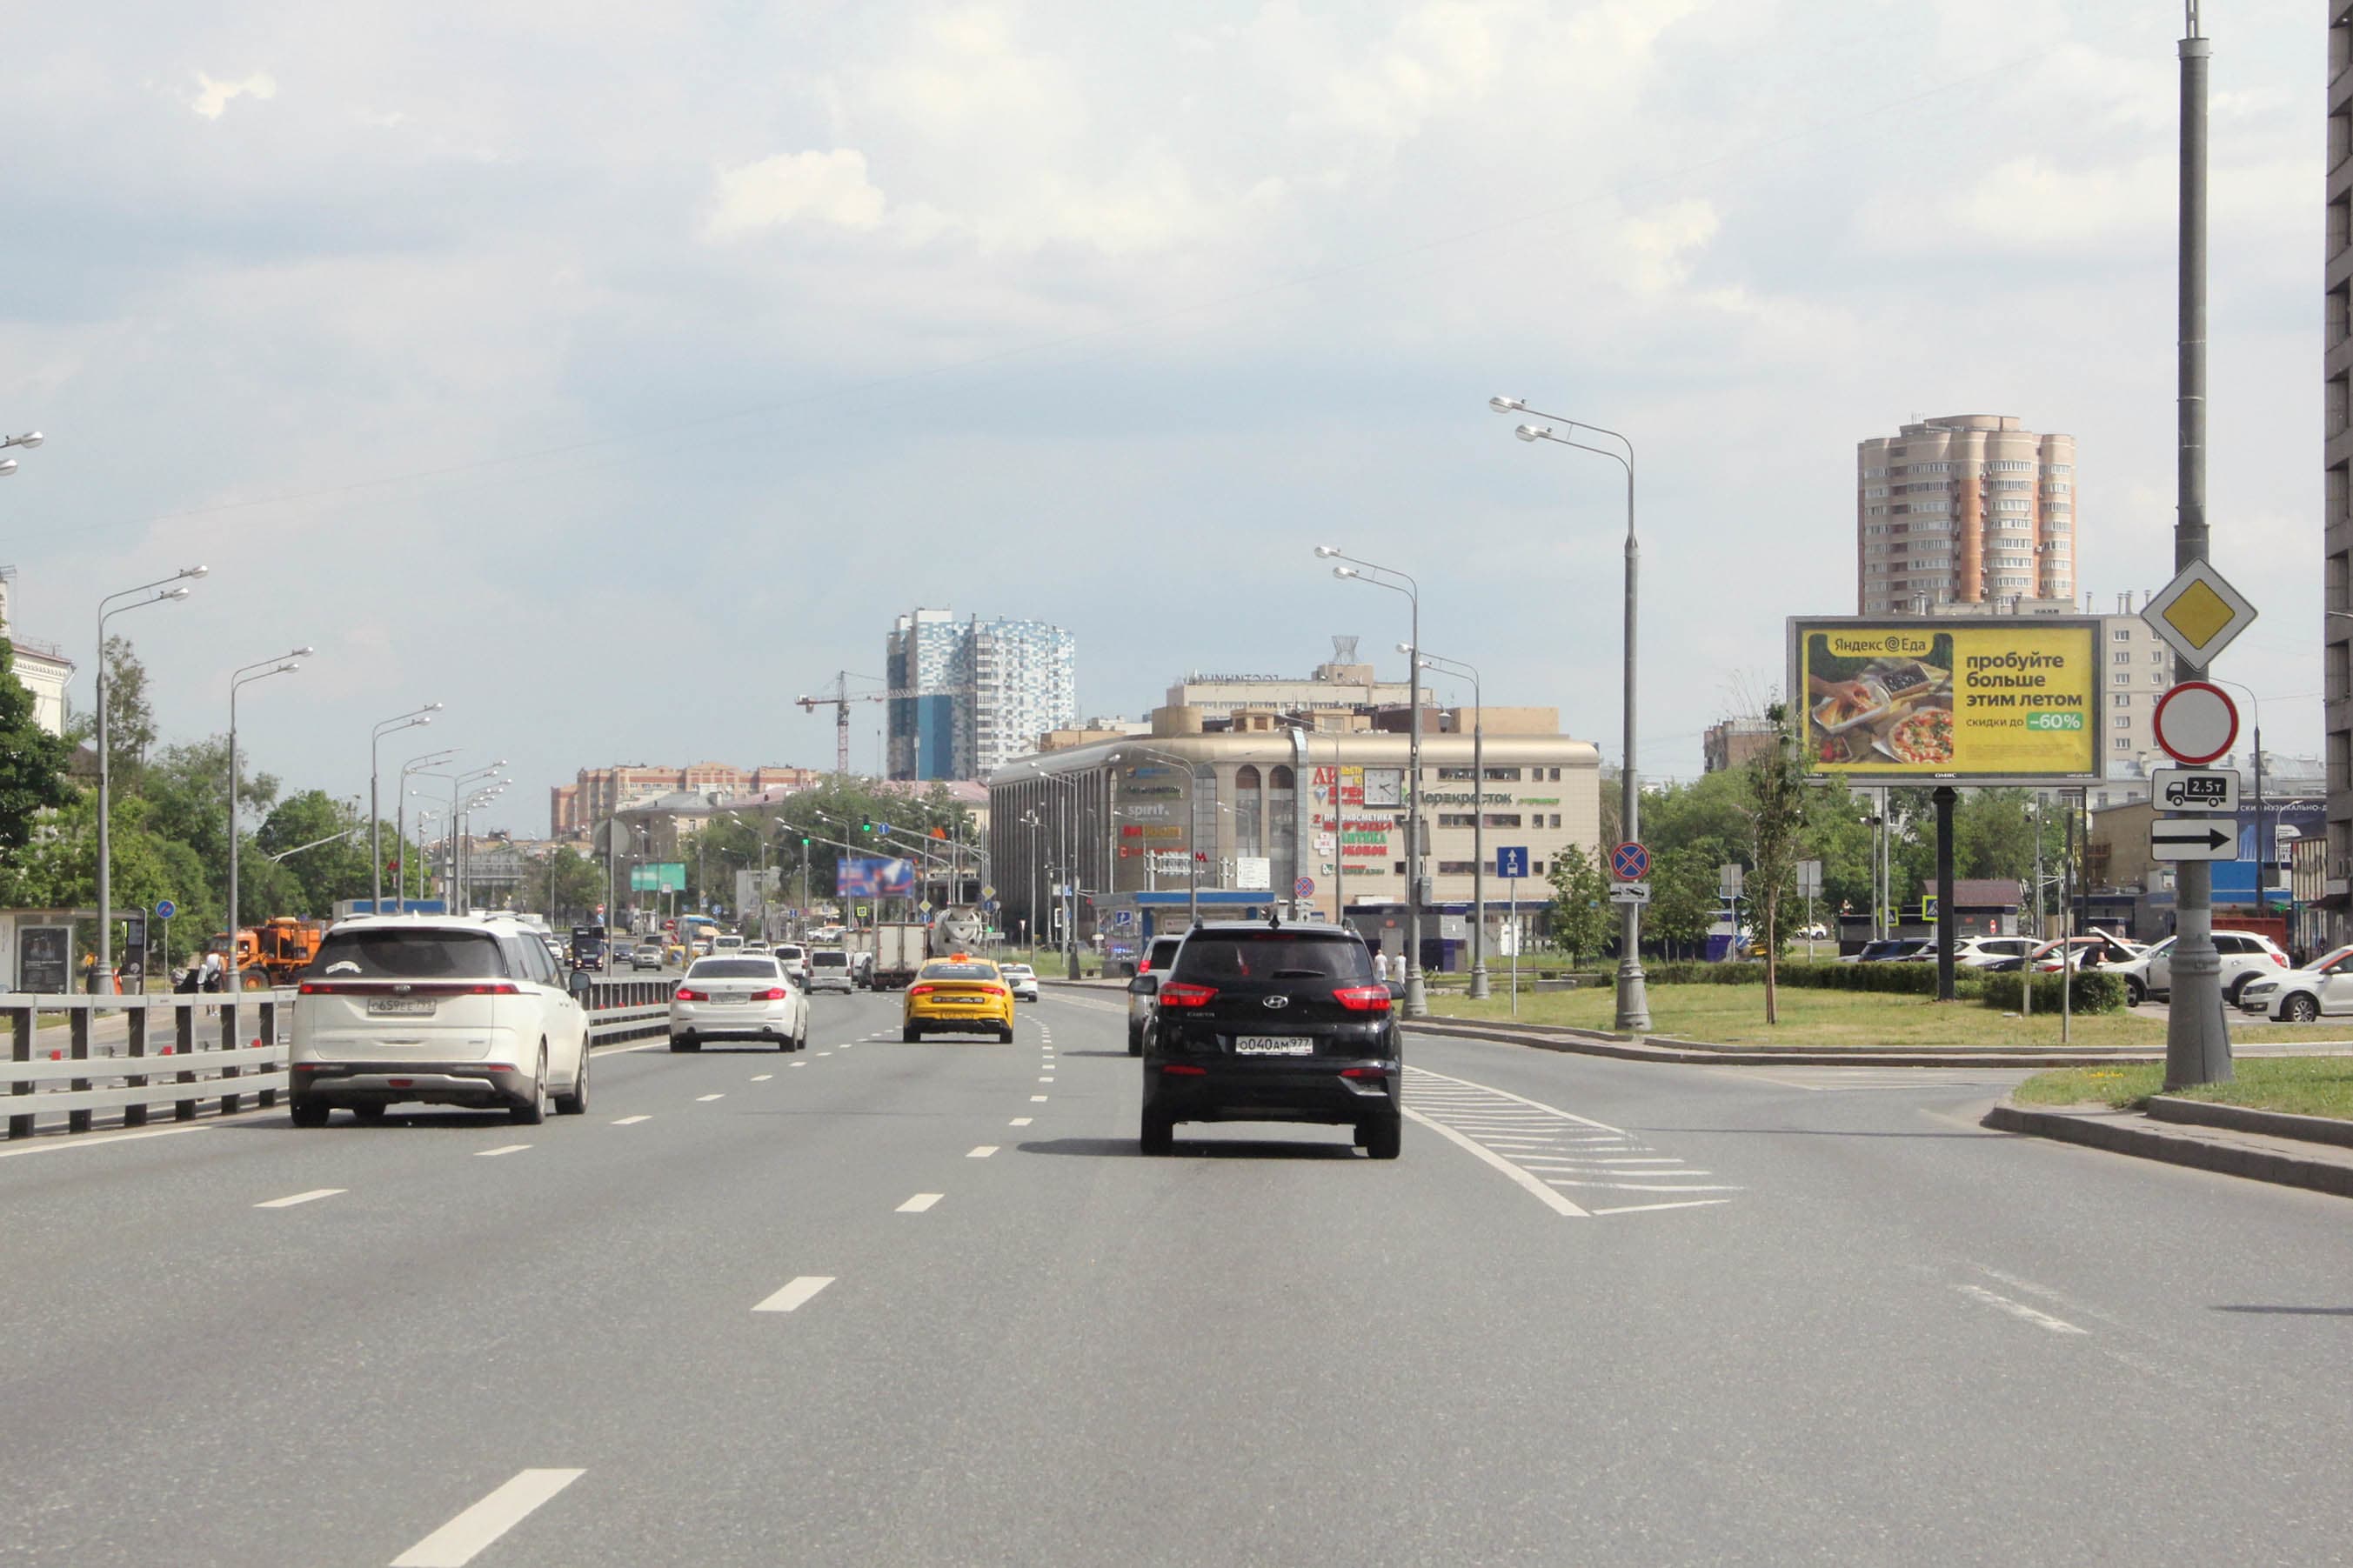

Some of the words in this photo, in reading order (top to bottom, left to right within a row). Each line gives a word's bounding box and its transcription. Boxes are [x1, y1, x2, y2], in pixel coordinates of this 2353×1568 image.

[1835, 638, 1883, 652] Яндекс
[1902, 637, 1926, 651] Еда
[1966, 651, 2064, 671] пробуйте
[1966, 671, 2046, 687] больше
[1966, 694, 2015, 707] этим
[2019, 694, 2082, 707] летом
[1966, 717, 2007, 728] скидки
[2009, 718, 2024, 728] до
